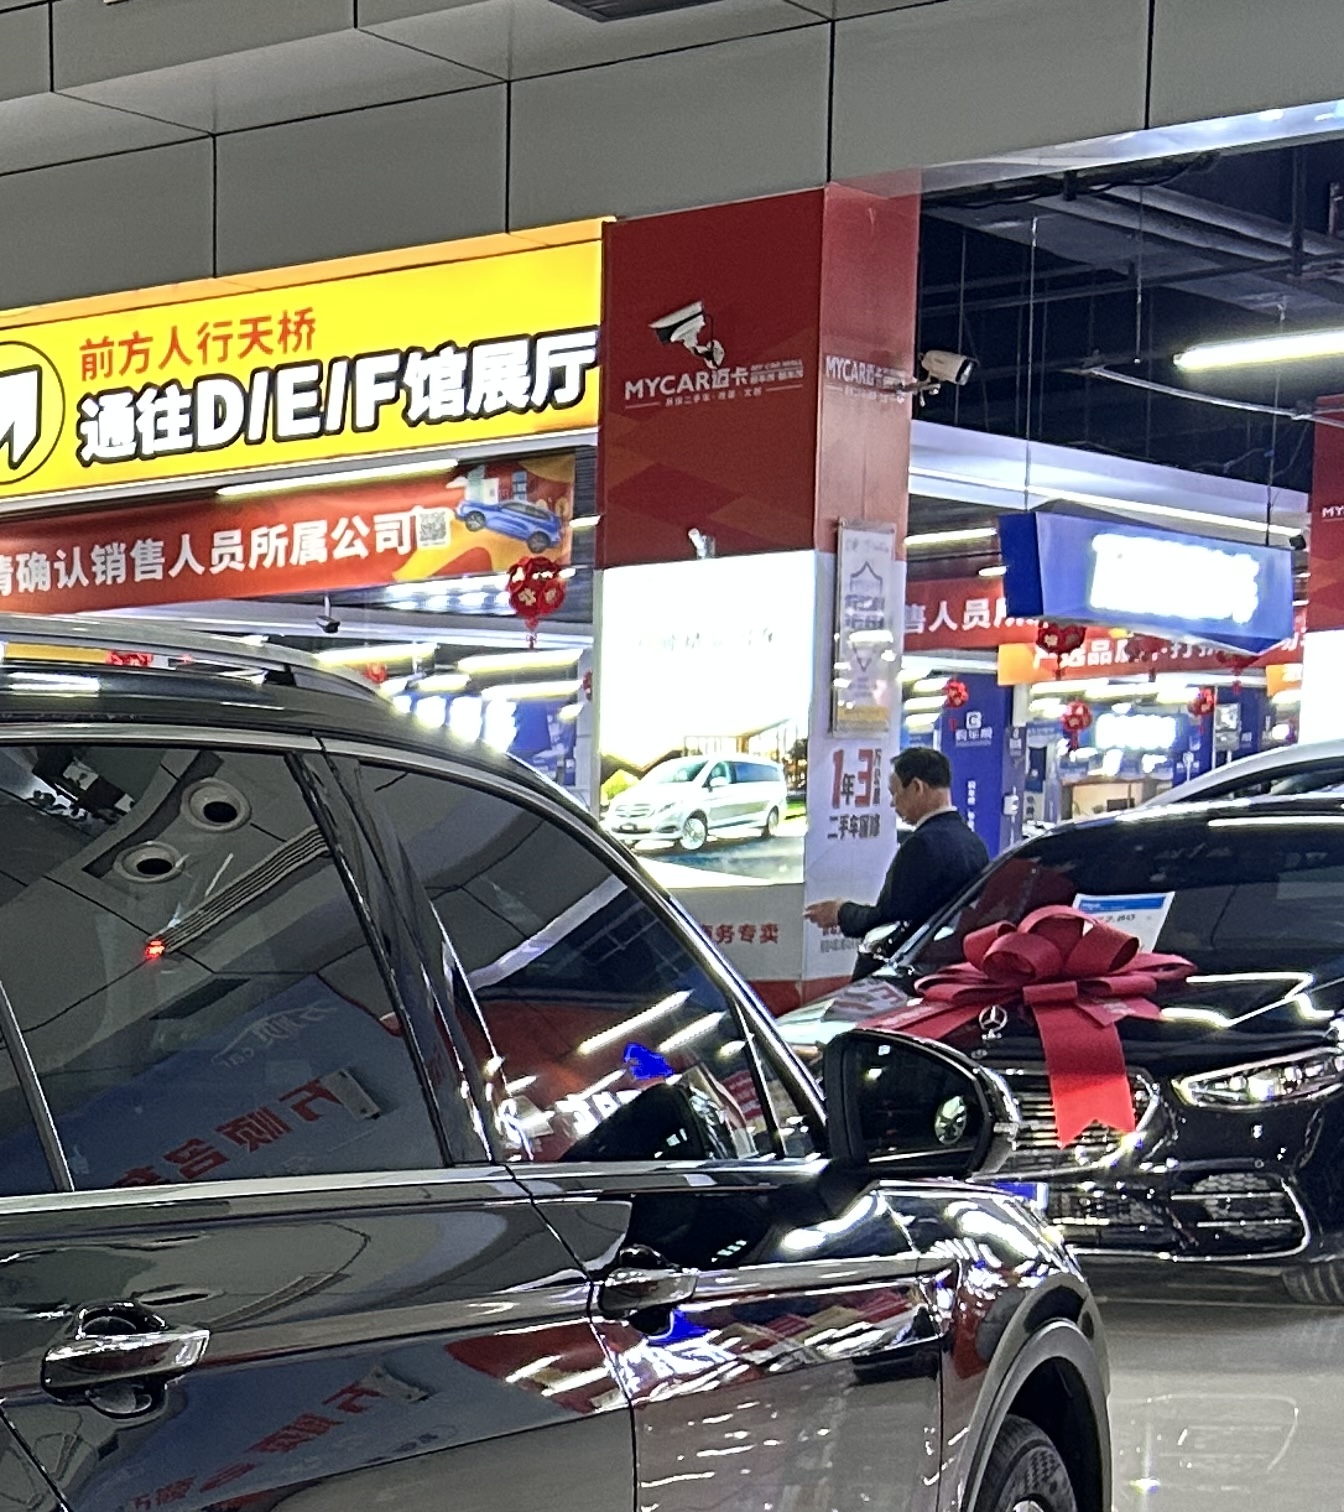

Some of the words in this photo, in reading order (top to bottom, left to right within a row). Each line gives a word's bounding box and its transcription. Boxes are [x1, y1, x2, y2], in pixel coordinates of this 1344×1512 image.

[79, 307, 316, 381] 前方人行天桥
[77, 325, 598, 467] 通往D/E/F馆展厅
[1322, 505, 1344, 518] MY
